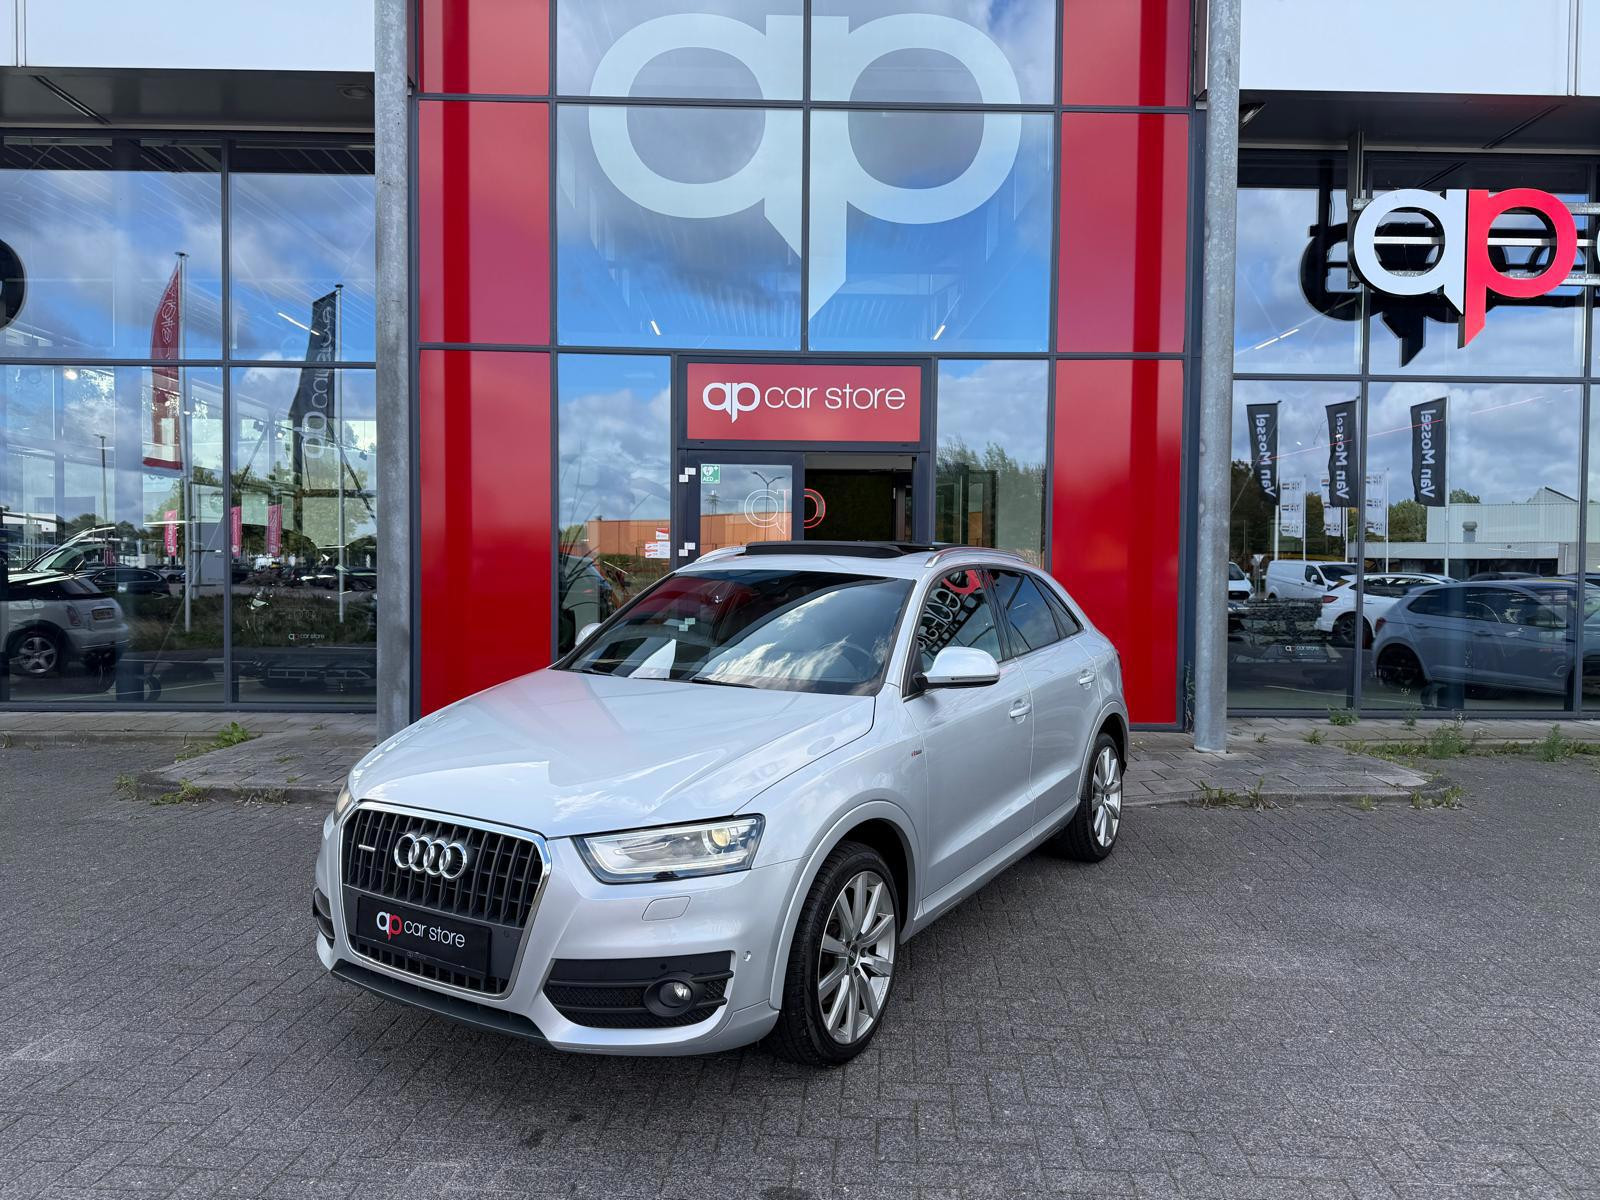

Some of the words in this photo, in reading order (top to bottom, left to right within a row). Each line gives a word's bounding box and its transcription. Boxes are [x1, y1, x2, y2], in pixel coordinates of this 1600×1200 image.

[588, 13, 1022, 321] ap
[1354, 188, 1578, 348] ap
[702, 382, 761, 423] ap
[764, 386, 818, 409] car
[825, 383, 906, 410] store
[376, 911, 403, 941] ap
[403, 920, 428, 937] car
[429, 926, 466, 948] store
